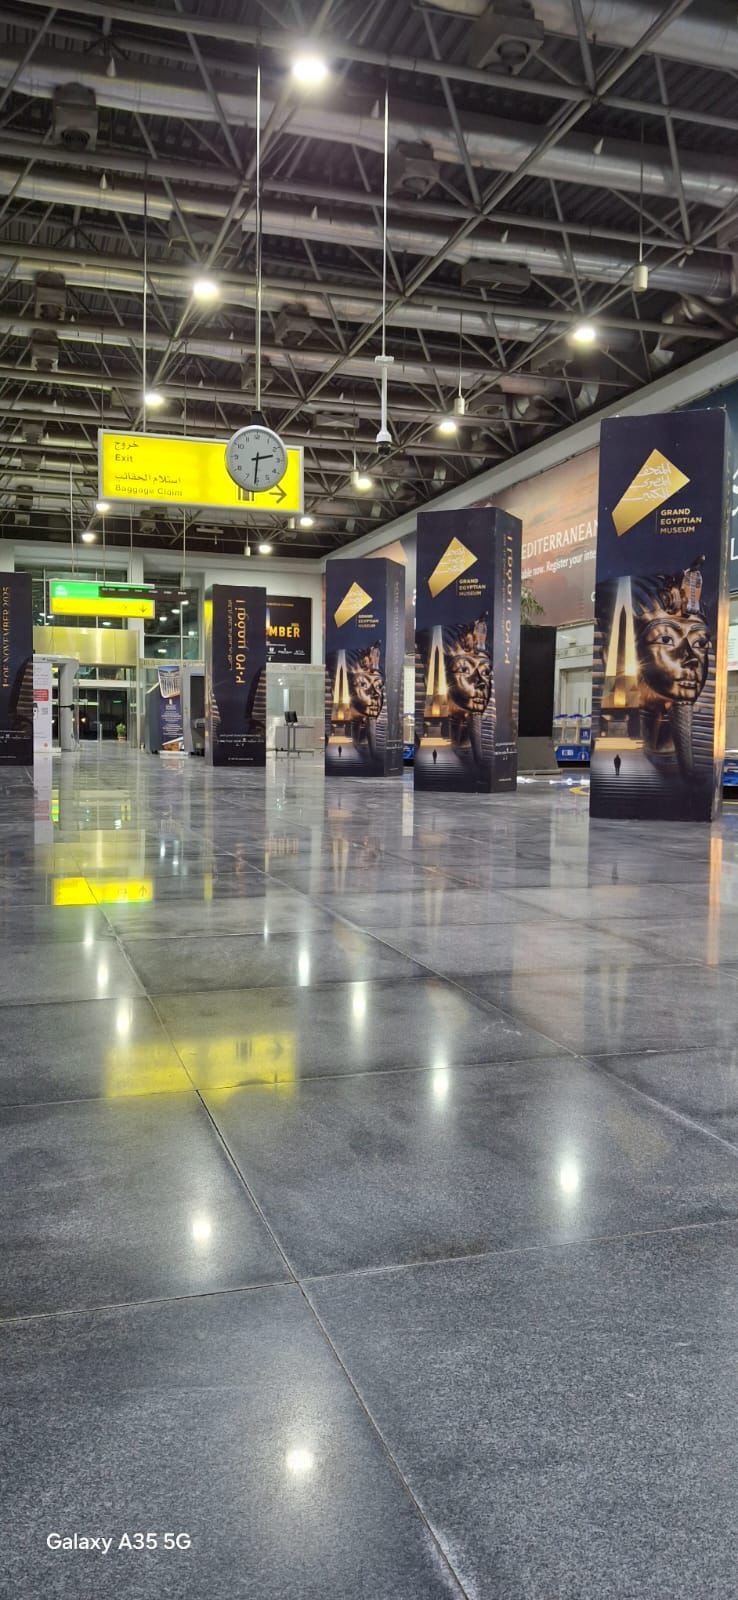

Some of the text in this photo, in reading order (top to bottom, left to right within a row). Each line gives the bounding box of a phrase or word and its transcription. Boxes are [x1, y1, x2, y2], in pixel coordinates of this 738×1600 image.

[114, 439, 140, 452] خروج
[114, 453, 133, 463] Exit
[115, 472, 181, 485] استلام الحقائب
[115, 484, 183, 497] Baggage Claim
[660, 508, 691, 516] GRAND
[660, 517, 702, 525] EGYPTIAN
[660, 526, 695, 534] MUSEUM
[546, 557, 569, 574] Register
[568, 554, 583, 568] your
[234, 607, 249, 650] نوفمبر
[267, 625, 300, 638] MBER
